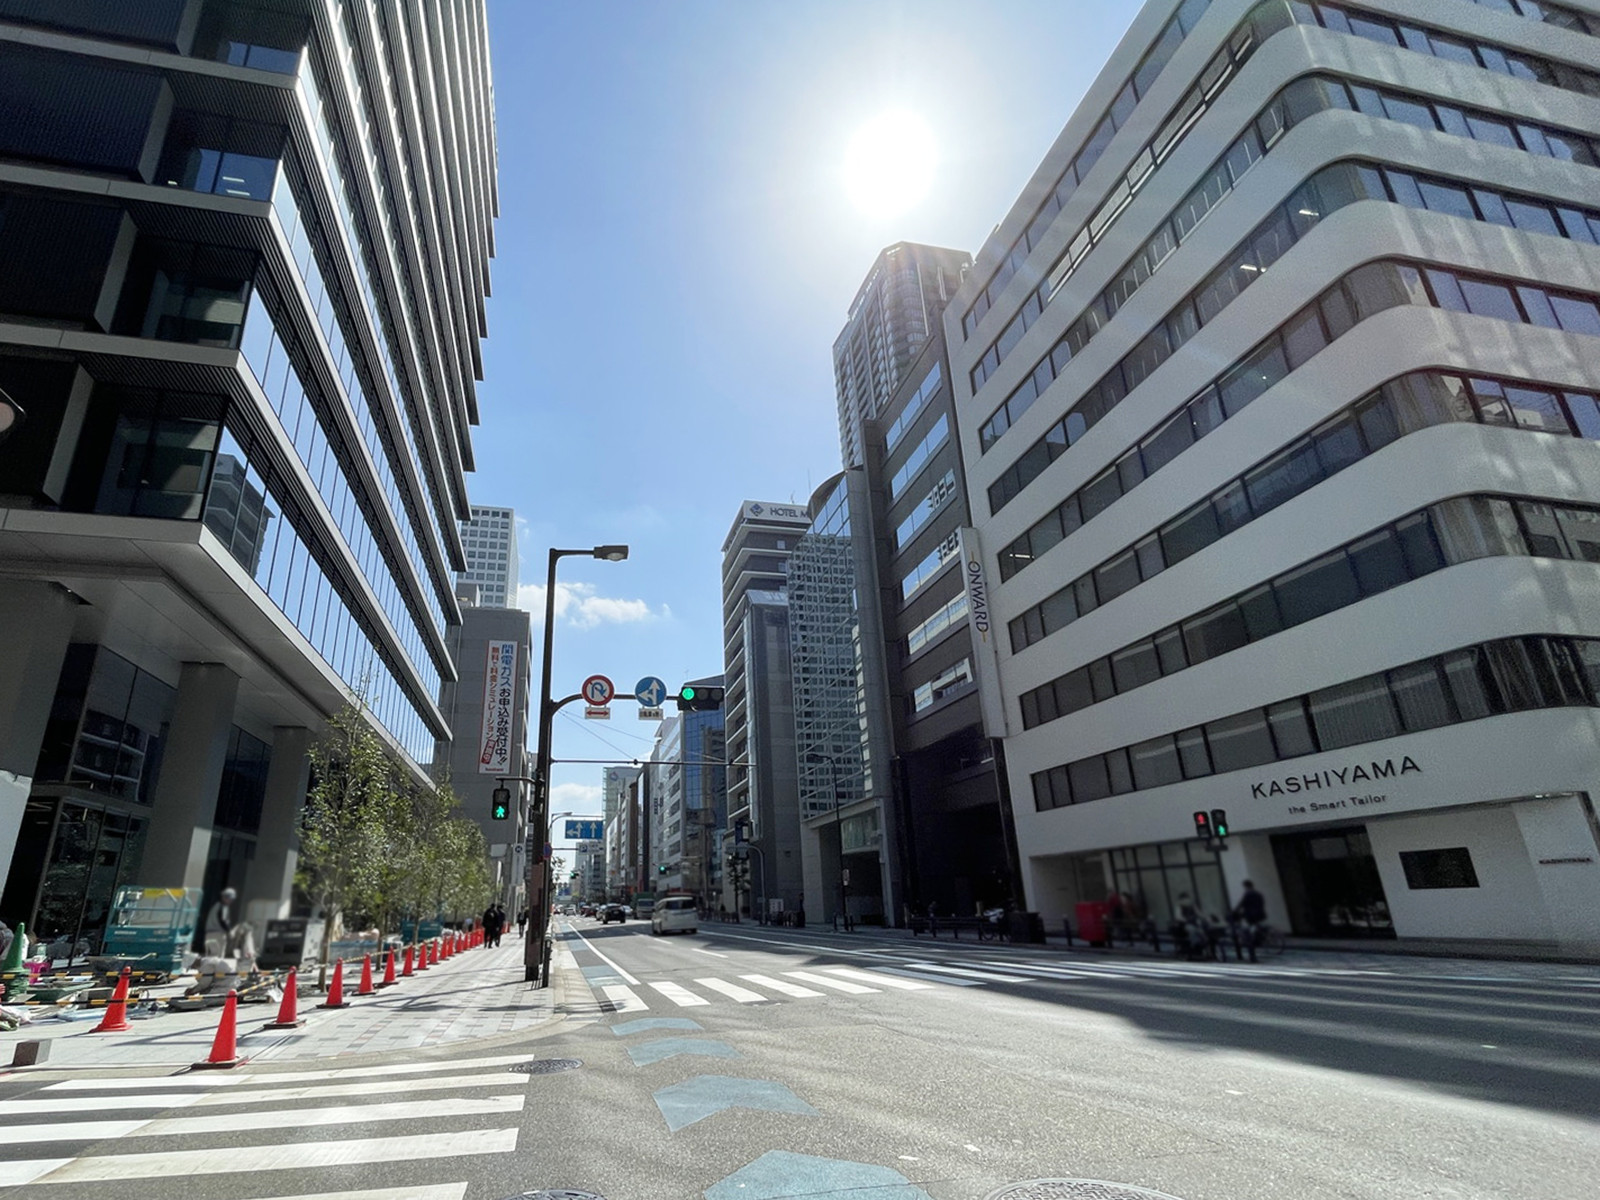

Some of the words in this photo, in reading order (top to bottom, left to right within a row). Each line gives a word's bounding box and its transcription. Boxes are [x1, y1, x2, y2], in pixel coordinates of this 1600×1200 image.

[770, 507, 798, 518] HOTEL
[968, 560, 989, 633] ONWARD
[1251, 755, 1421, 800] KASHIYAMA
[1288, 805, 1306, 815] the
[1310, 800, 1347, 812] Smart
[1350, 793, 1388, 807] Tailor
